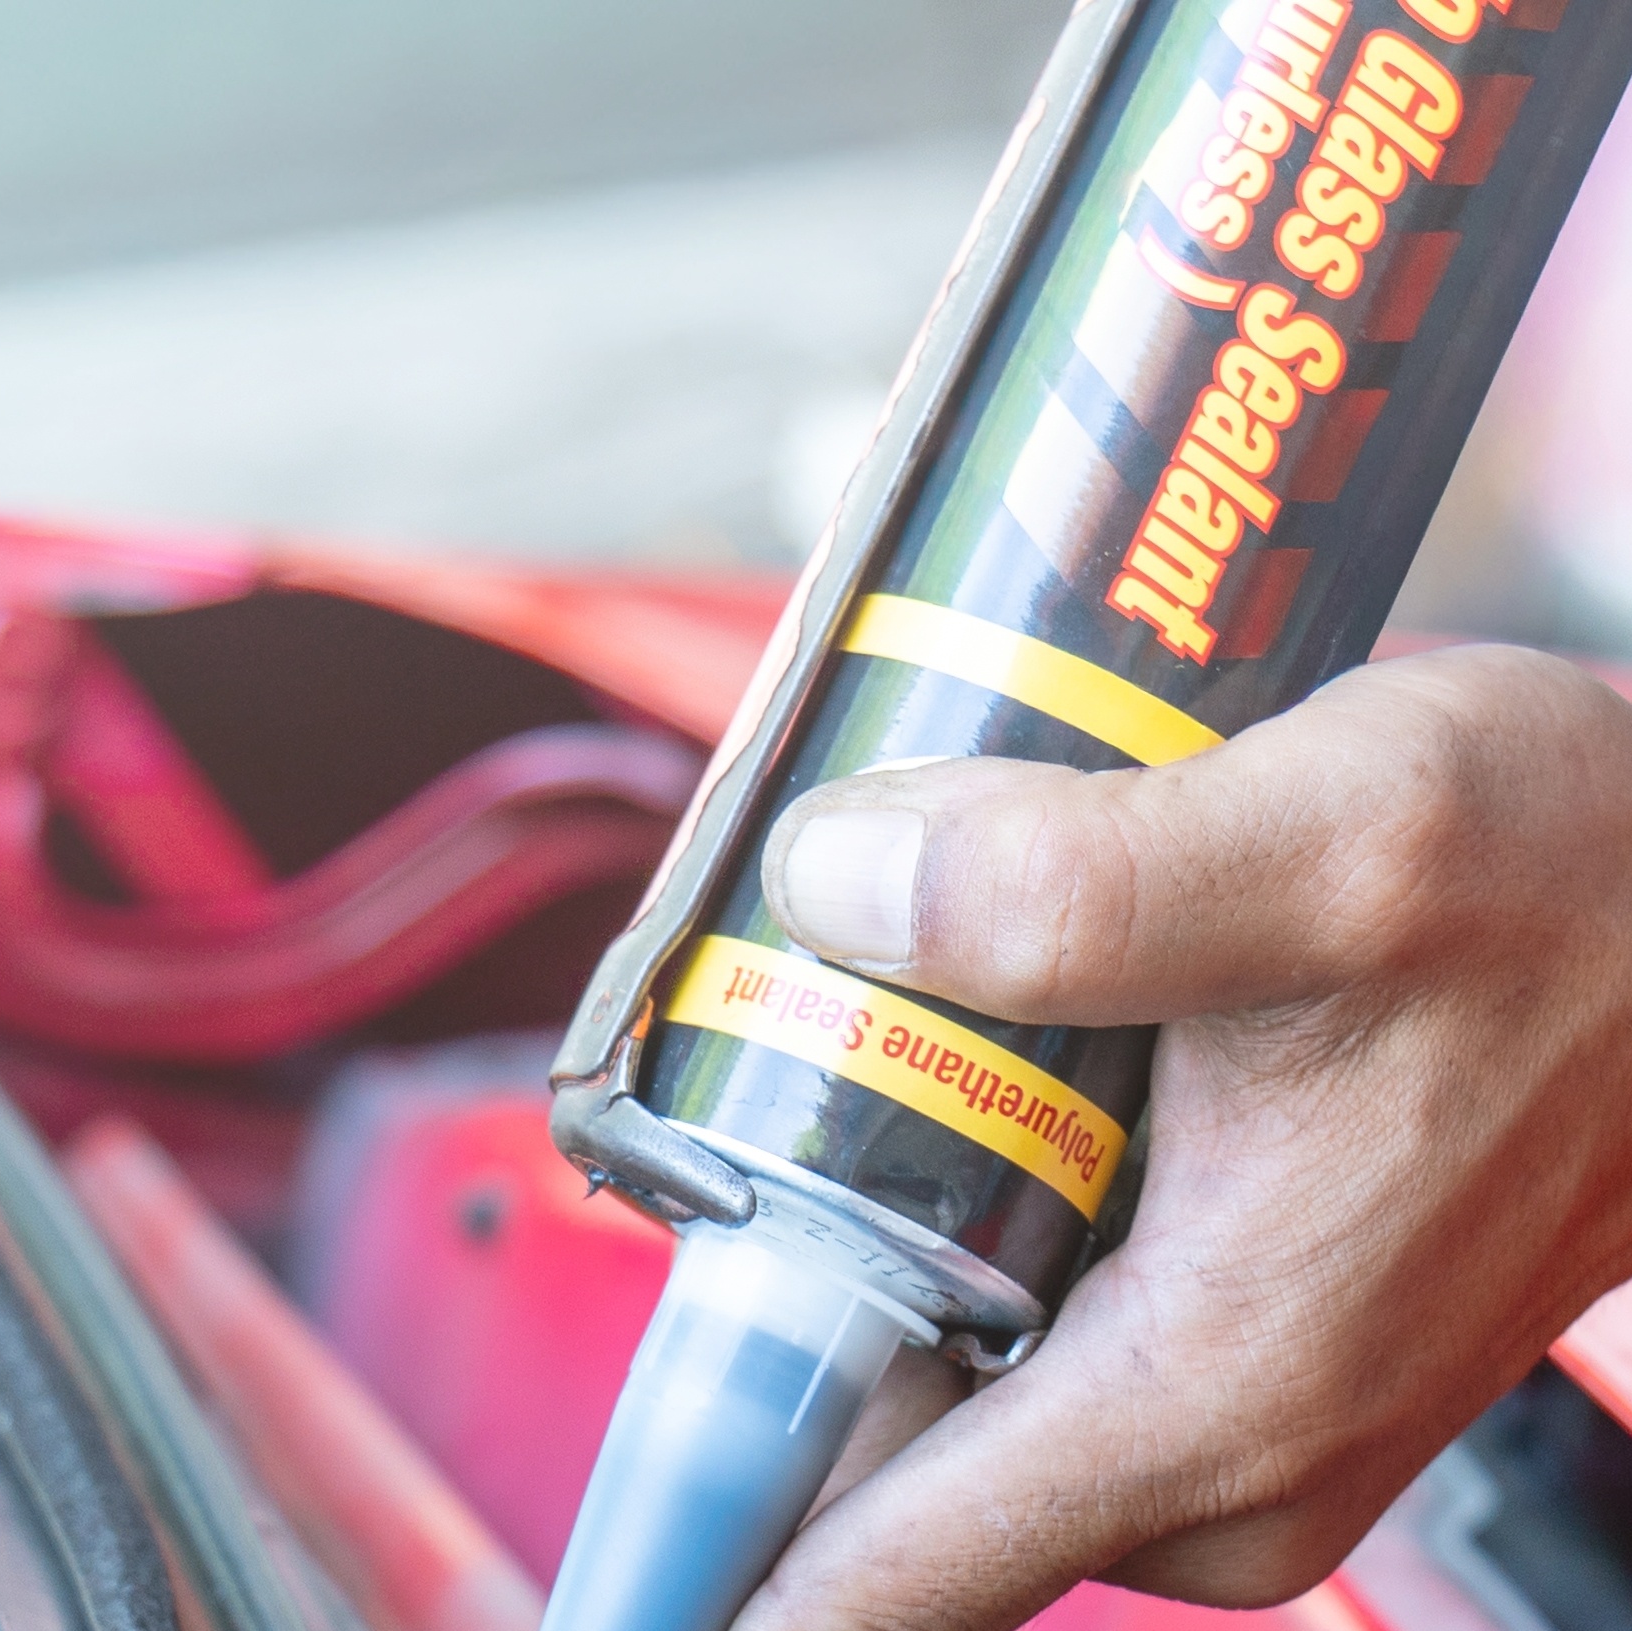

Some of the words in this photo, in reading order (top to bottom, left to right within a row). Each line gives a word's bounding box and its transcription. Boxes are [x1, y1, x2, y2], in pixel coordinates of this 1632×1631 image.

[1274, 29, 1464, 300] Glass
[1105, 282, 1347, 667] Sealant
[723, 965, 873, 1051] Sealant
[881, 1025, 1106, 1185] Polyurethane
